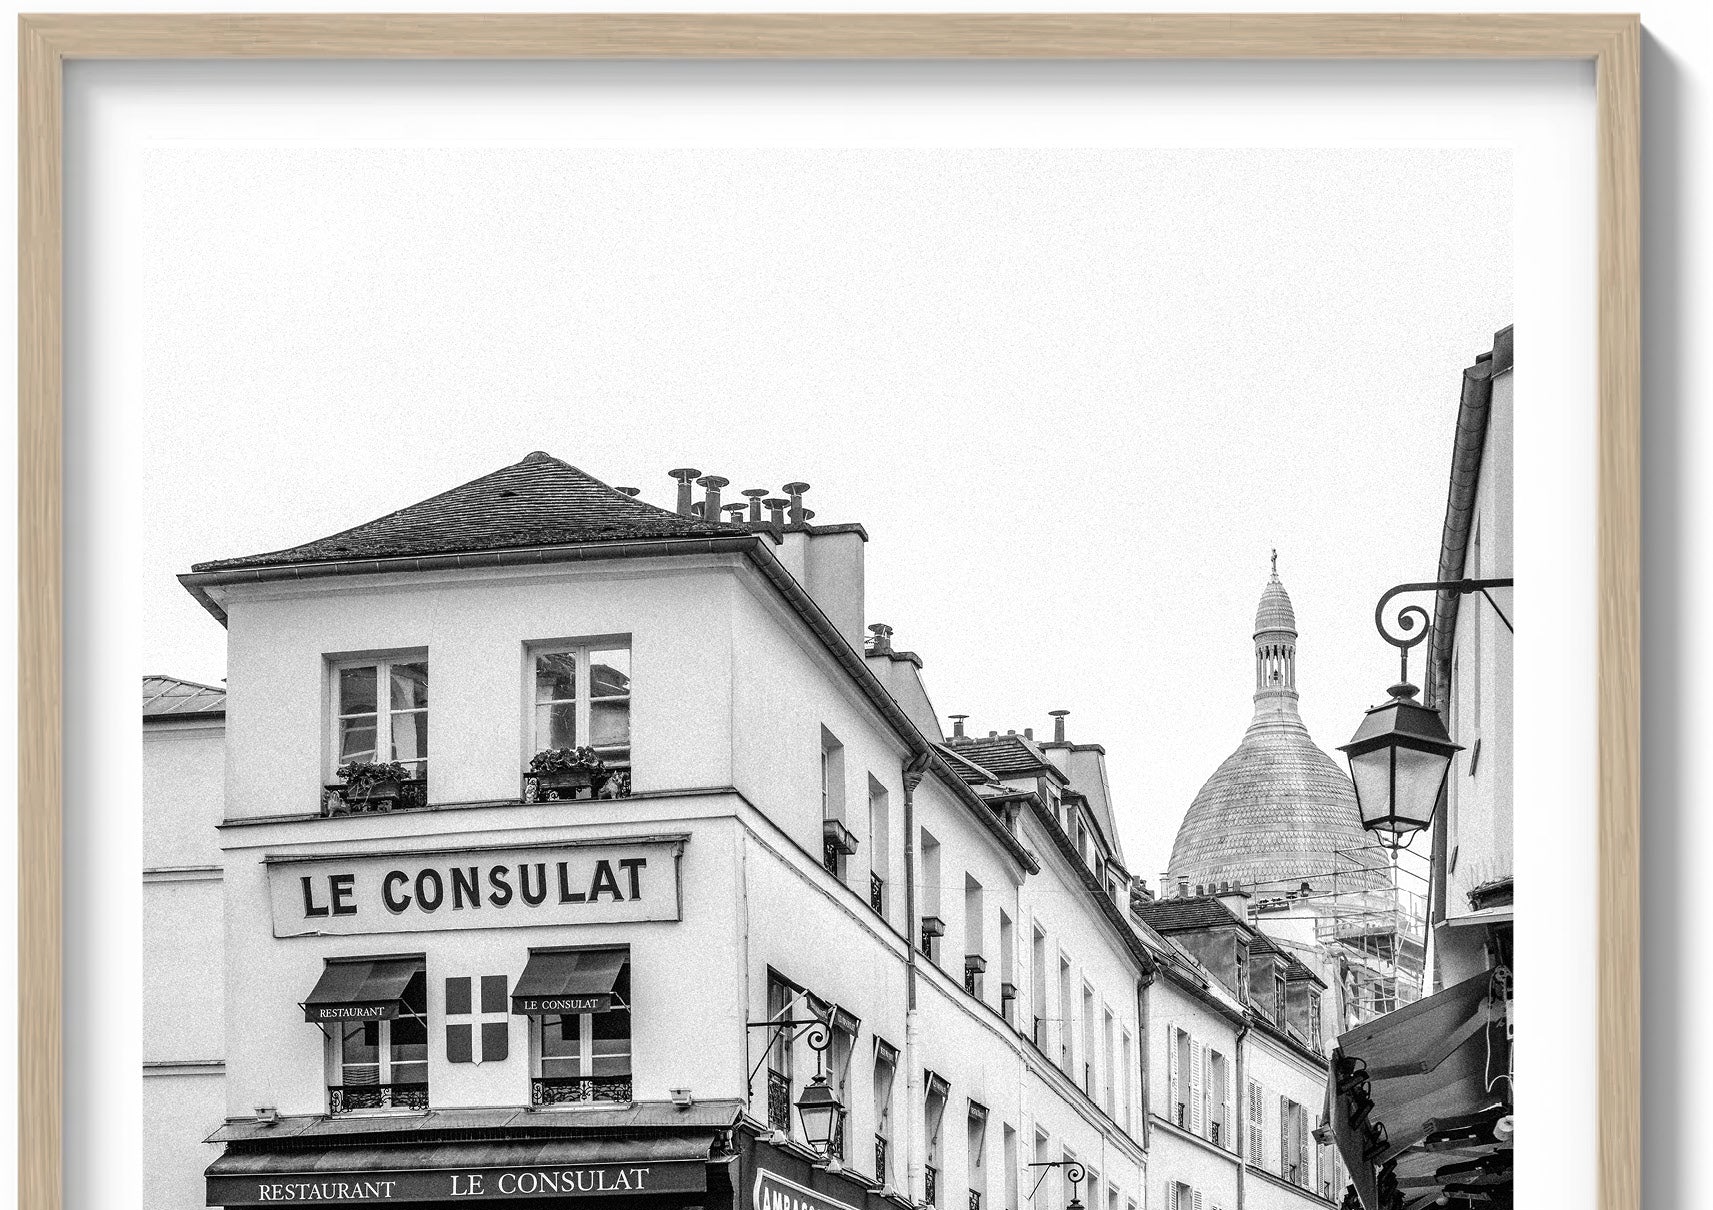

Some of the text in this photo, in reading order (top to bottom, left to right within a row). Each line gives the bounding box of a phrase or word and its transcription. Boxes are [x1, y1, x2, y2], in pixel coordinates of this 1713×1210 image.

[300, 858, 647, 919] LE CONSULAT
[320, 1006, 385, 1018] RESTAURANT
[524, 999, 599, 1010] LE CONSULAT
[258, 1168, 650, 1201] RESTAURANT LE CONSULAT
